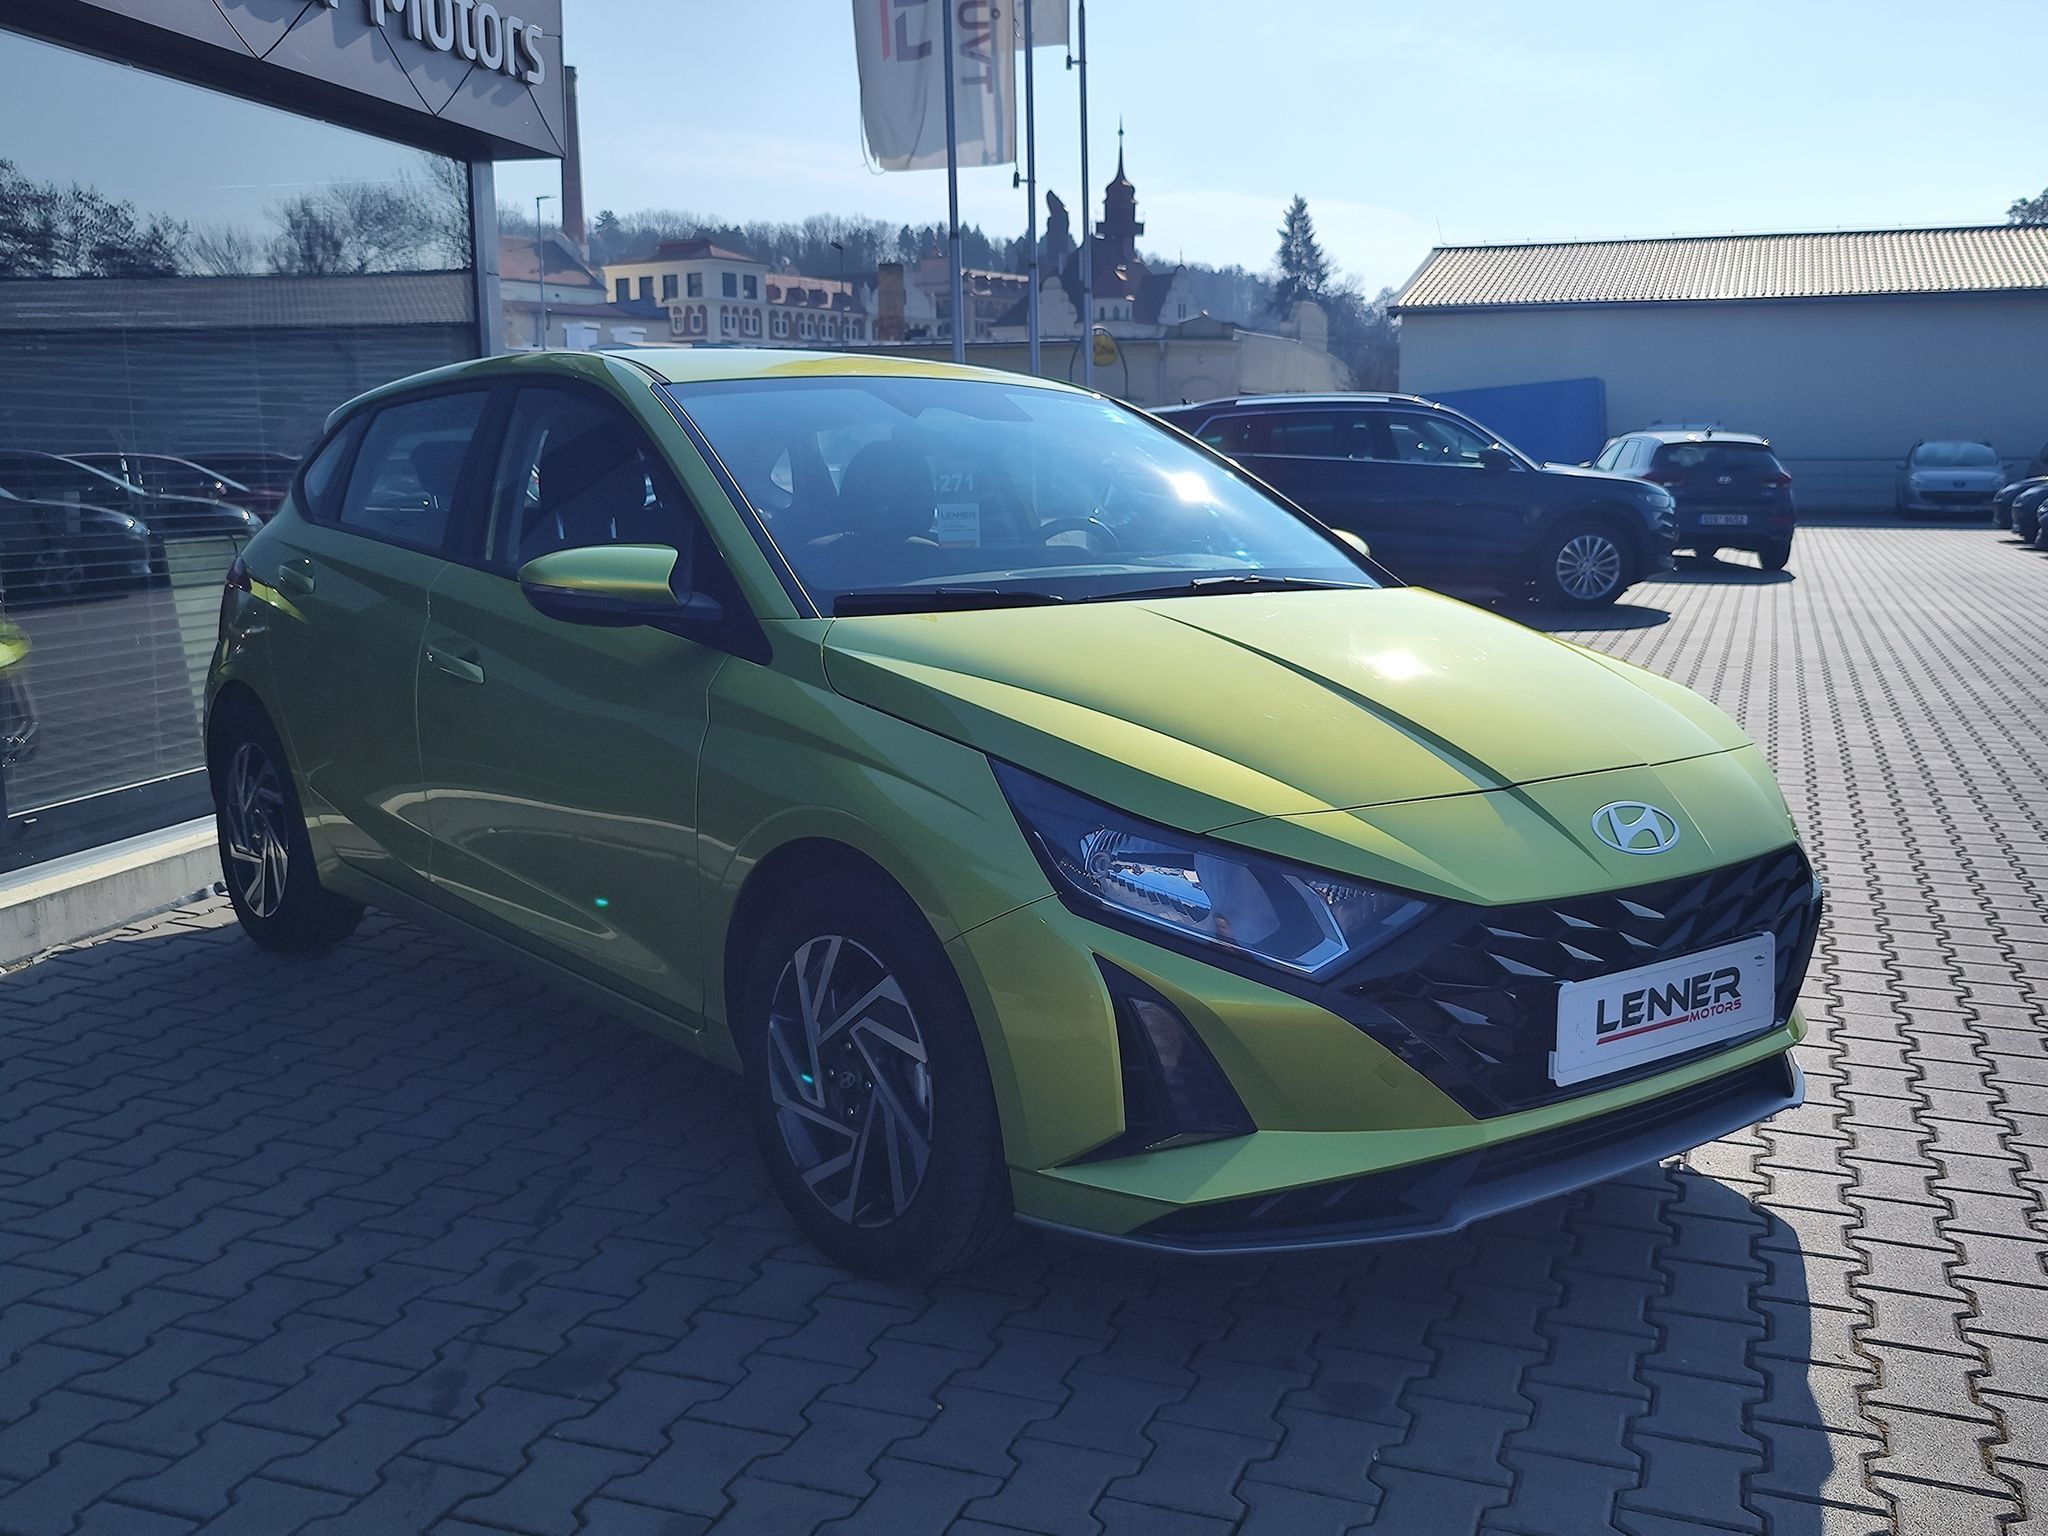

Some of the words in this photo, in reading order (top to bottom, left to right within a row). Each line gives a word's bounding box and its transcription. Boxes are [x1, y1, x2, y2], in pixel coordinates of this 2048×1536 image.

[940, 474, 974, 492] 271
[1596, 966, 1741, 1035] LENNER
[1689, 998, 1742, 1022] MOTORS
